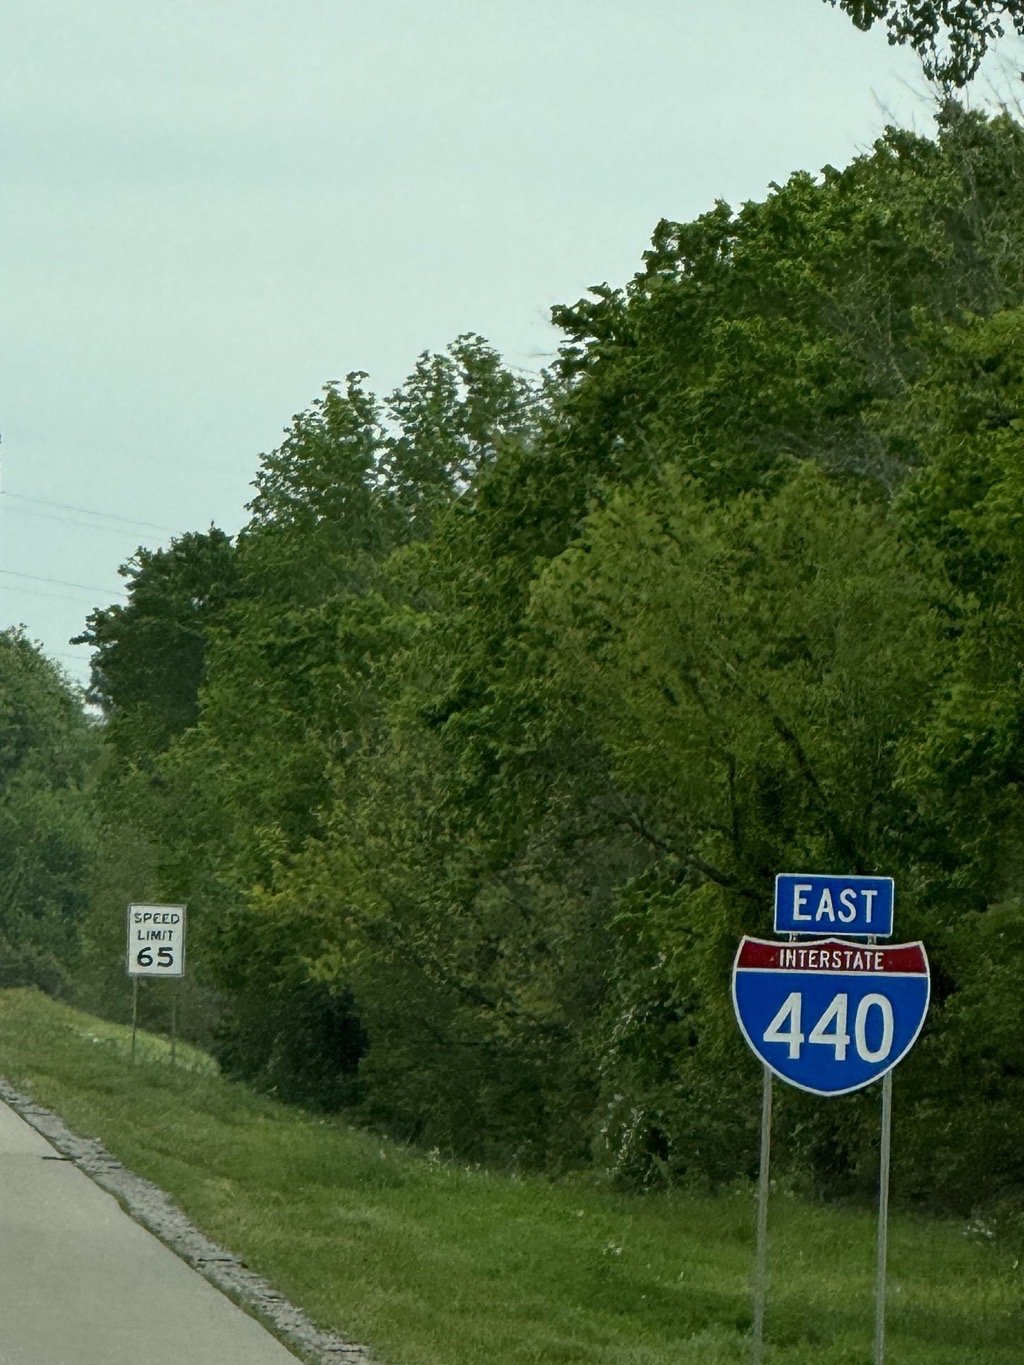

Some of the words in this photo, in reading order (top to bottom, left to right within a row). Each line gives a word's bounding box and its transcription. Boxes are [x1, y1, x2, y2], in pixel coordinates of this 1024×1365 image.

[792, 884, 878, 923] EAST
[133, 912, 180, 925] SPEED
[137, 929, 174, 941] LIMIT
[136, 946, 174, 968] 65
[779, 948, 885, 970] INTERSTATE
[762, 992, 894, 1063] 440
